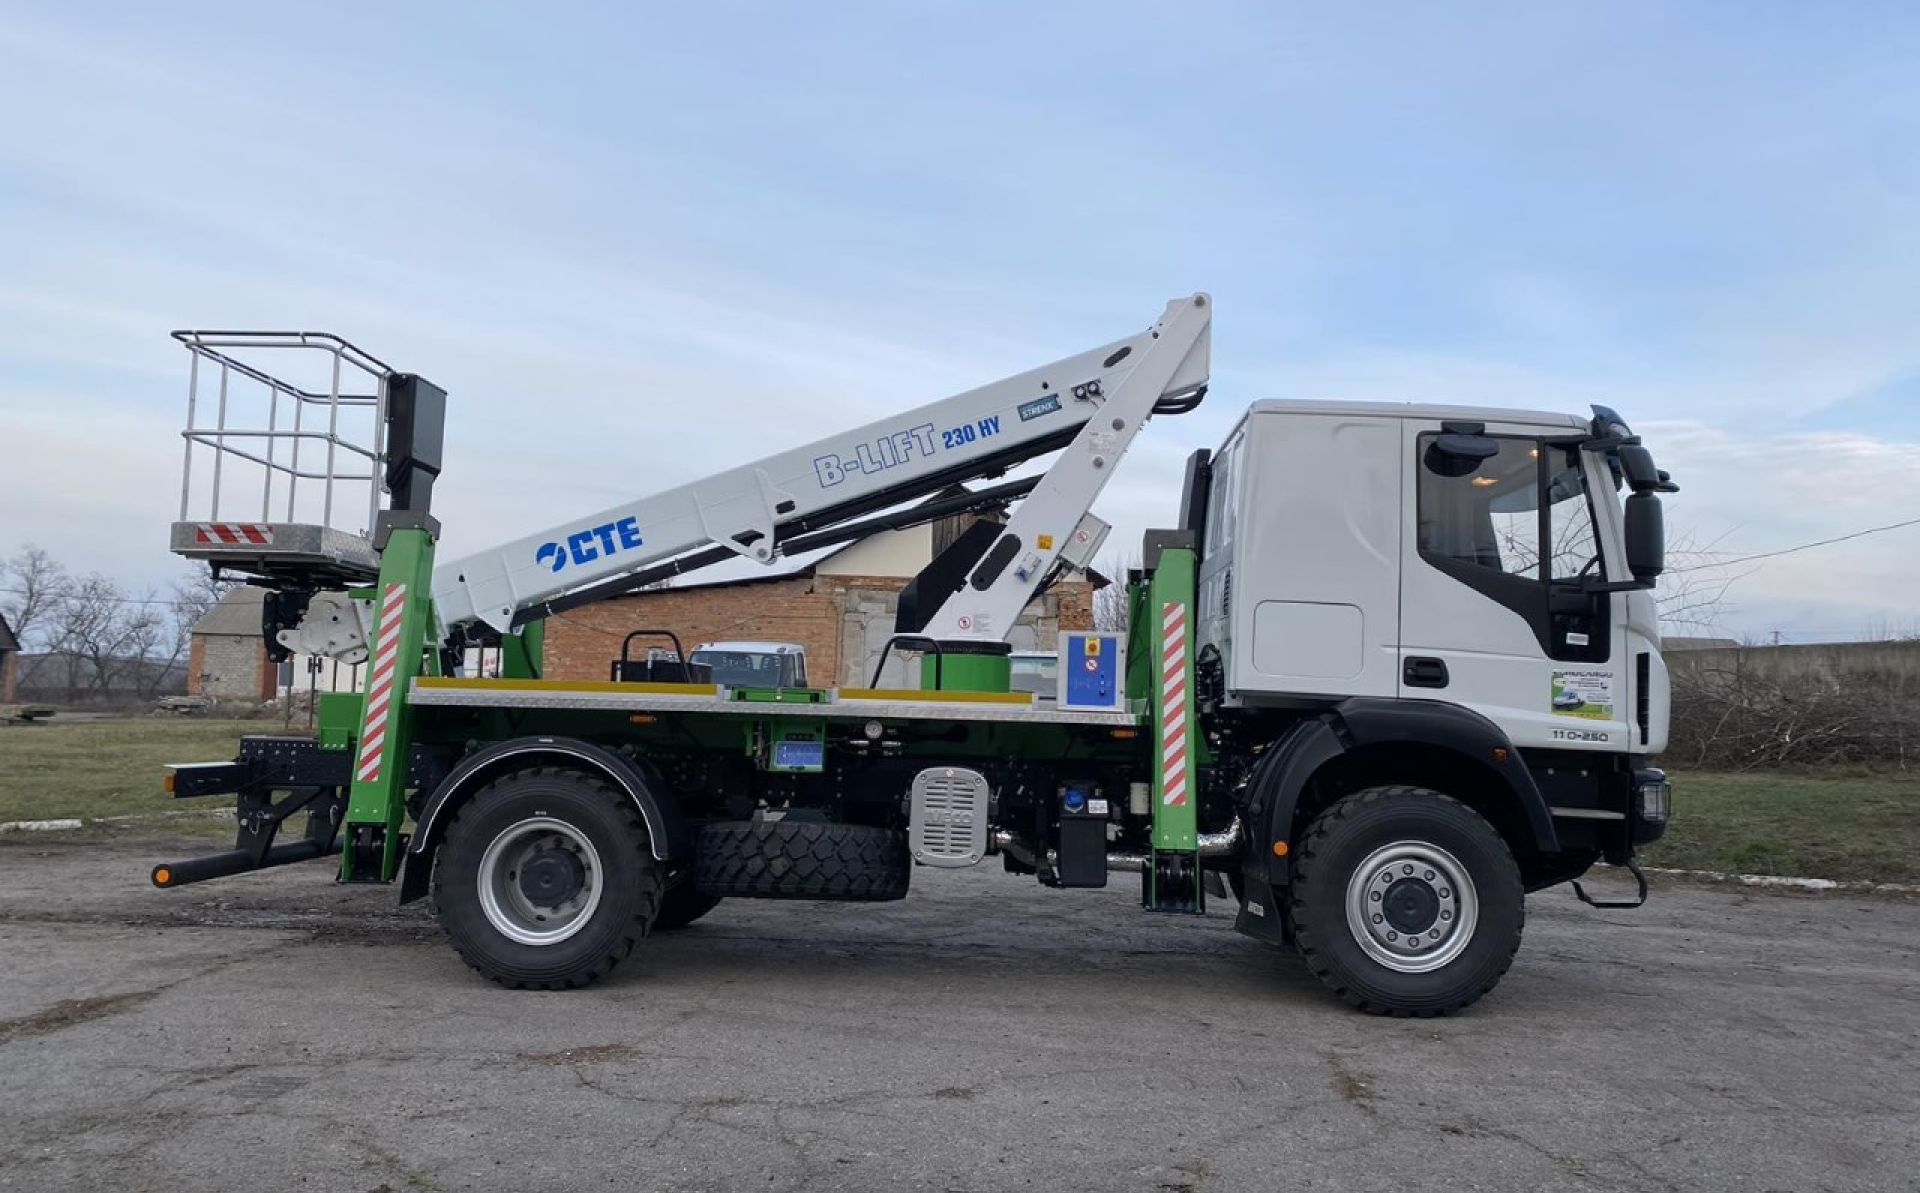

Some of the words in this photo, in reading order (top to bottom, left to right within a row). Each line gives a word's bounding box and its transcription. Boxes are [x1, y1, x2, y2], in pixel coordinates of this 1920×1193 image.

[814, 422, 935, 489] B-LIFT
[942, 424, 976, 450] 230
[978, 415, 1000, 439] HY
[567, 515, 643, 566] CTE
